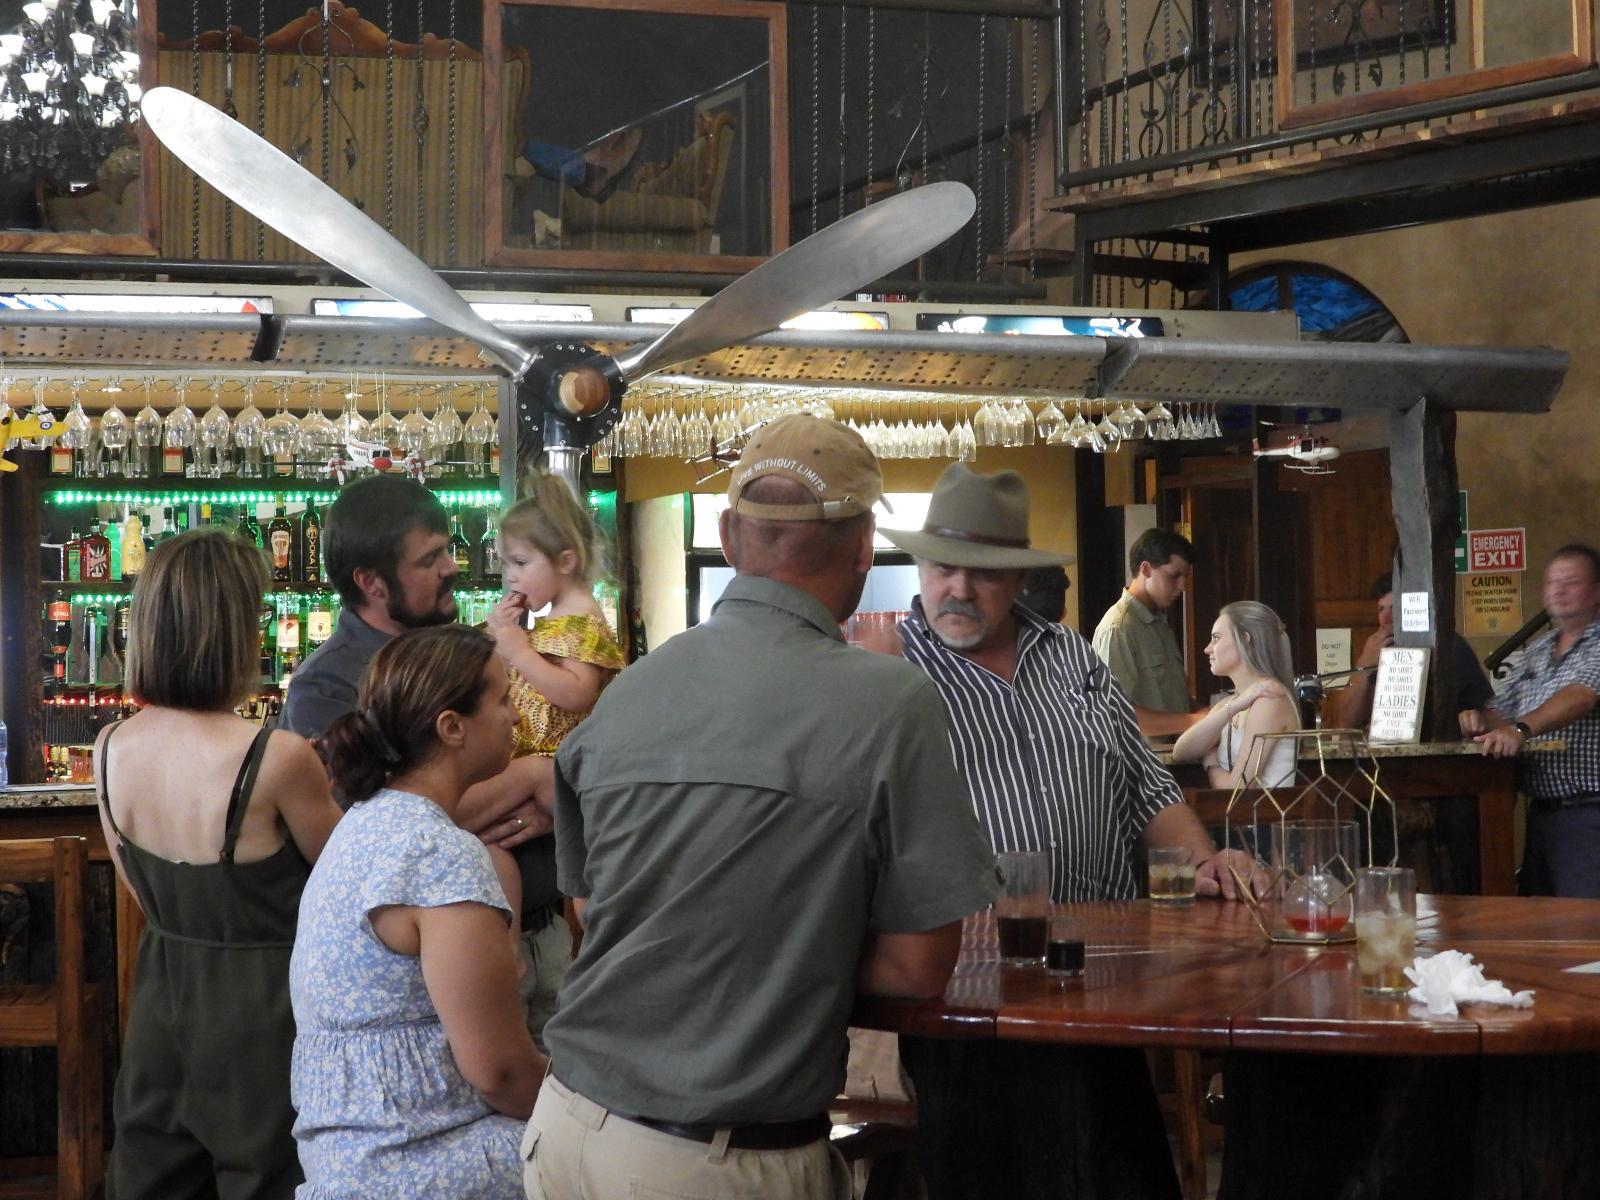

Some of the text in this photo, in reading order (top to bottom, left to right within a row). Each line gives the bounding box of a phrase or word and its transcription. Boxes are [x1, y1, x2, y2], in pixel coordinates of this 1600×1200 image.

[754, 458, 797, 472] WITHOUT
[796, 464, 827, 492] LIMITS
[1473, 535, 1520, 551] EMERGENCY
[1474, 550, 1519, 567] EXIT
[1471, 575, 1512, 587] CAUTION
[1393, 650, 1414, 664] MEN
[1389, 666, 1396, 674] NO
[1378, 695, 1417, 708] LADIES
